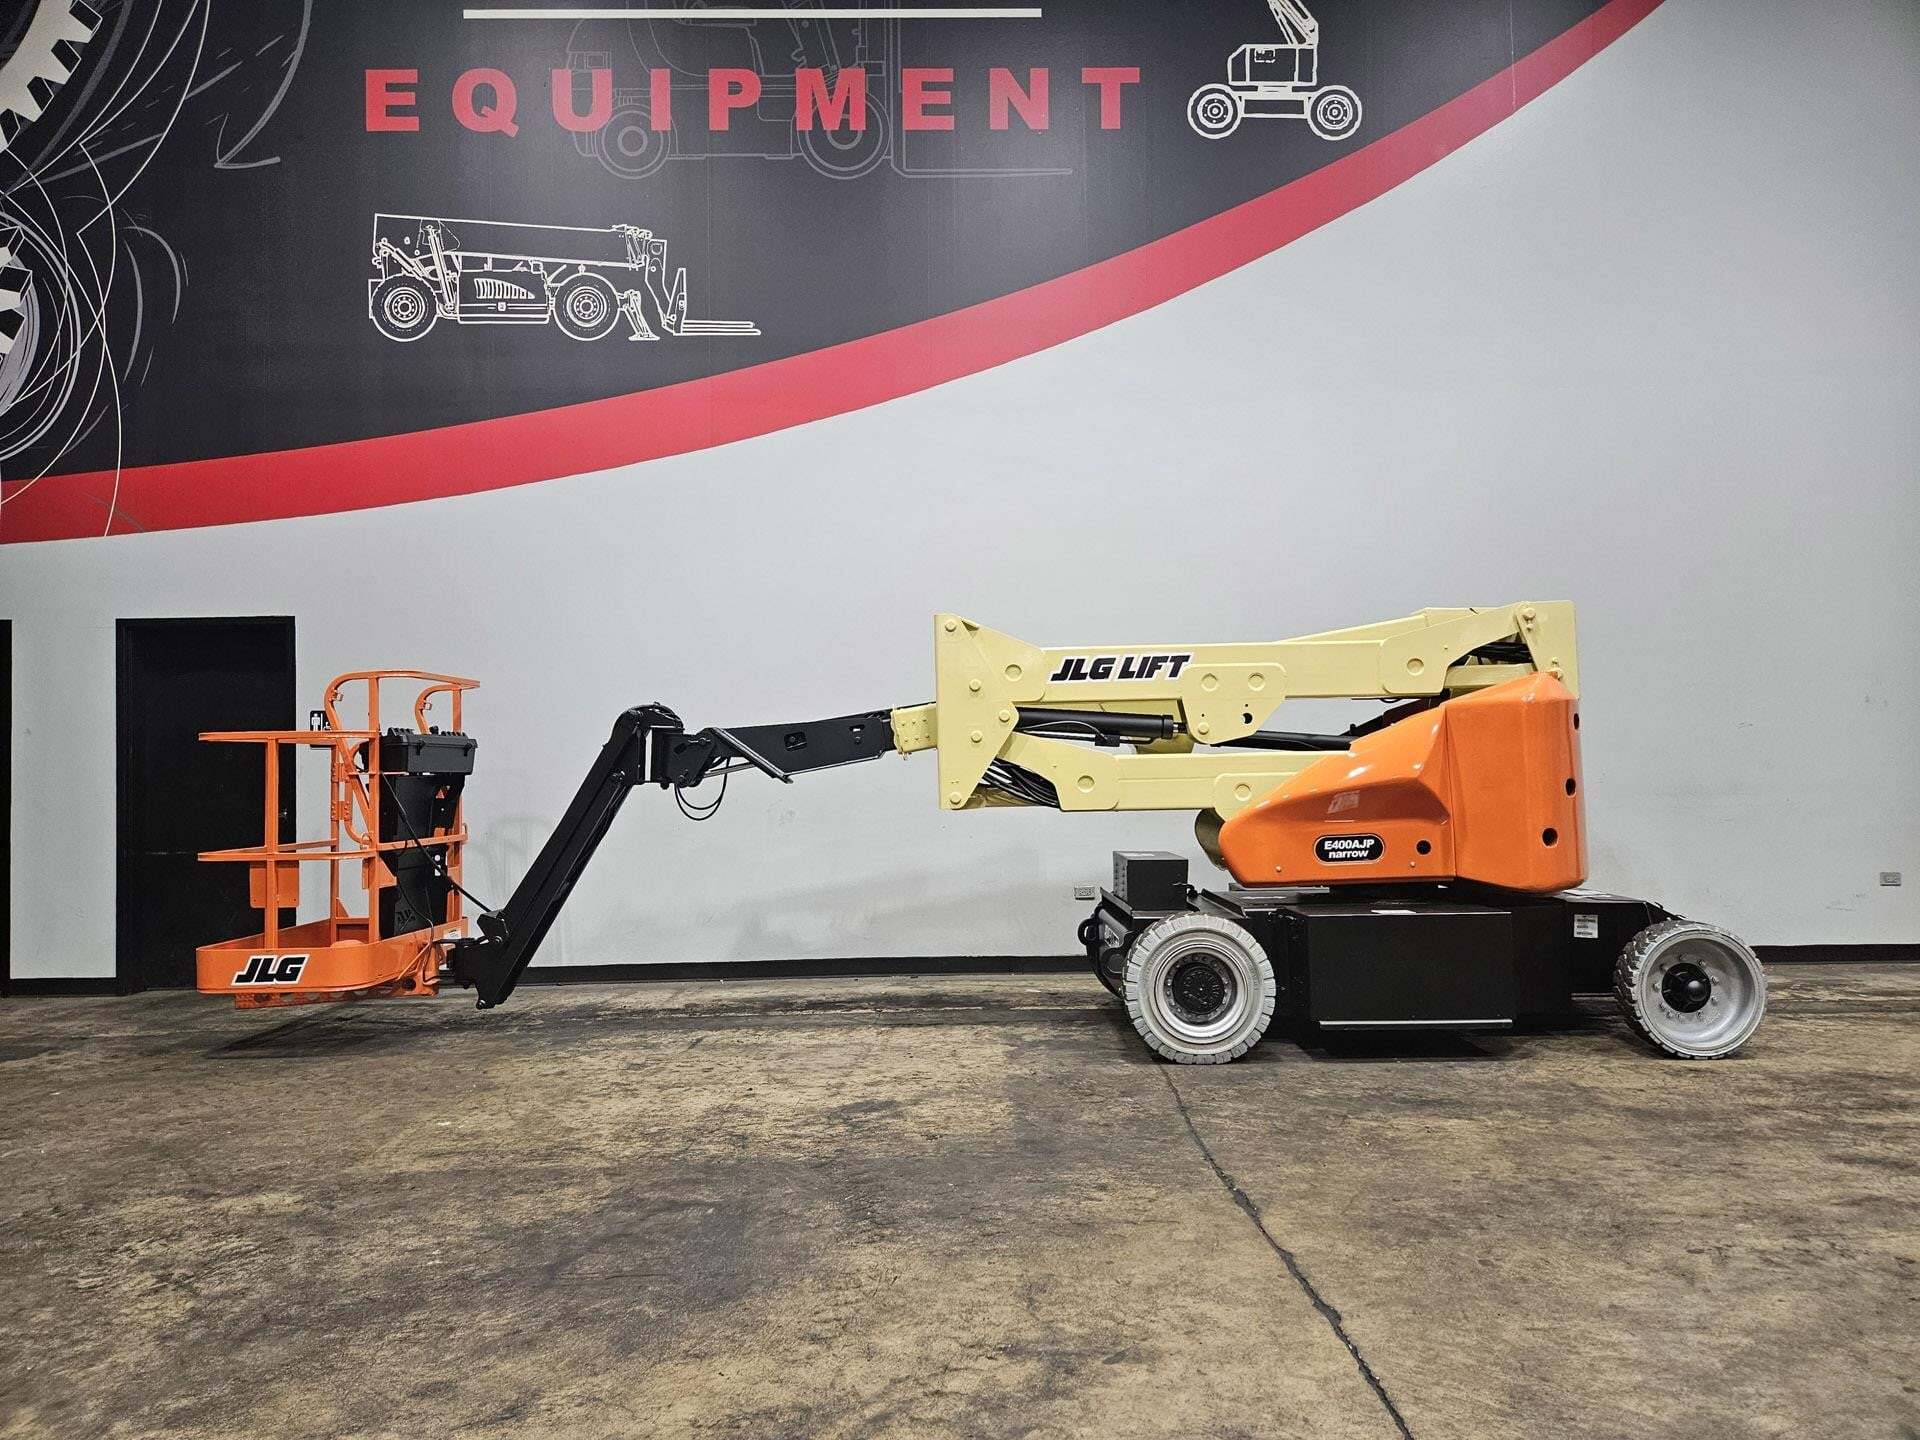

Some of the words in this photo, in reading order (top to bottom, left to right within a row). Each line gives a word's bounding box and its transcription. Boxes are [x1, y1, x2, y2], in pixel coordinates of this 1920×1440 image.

[364, 67, 1141, 138] EQUIPMENT
[1050, 657, 1117, 681] JLG
[1117, 655, 1191, 679] LIFT
[1324, 839, 1375, 850] E400AJP
[1328, 850, 1369, 859] narrow
[234, 956, 307, 983] JLG
